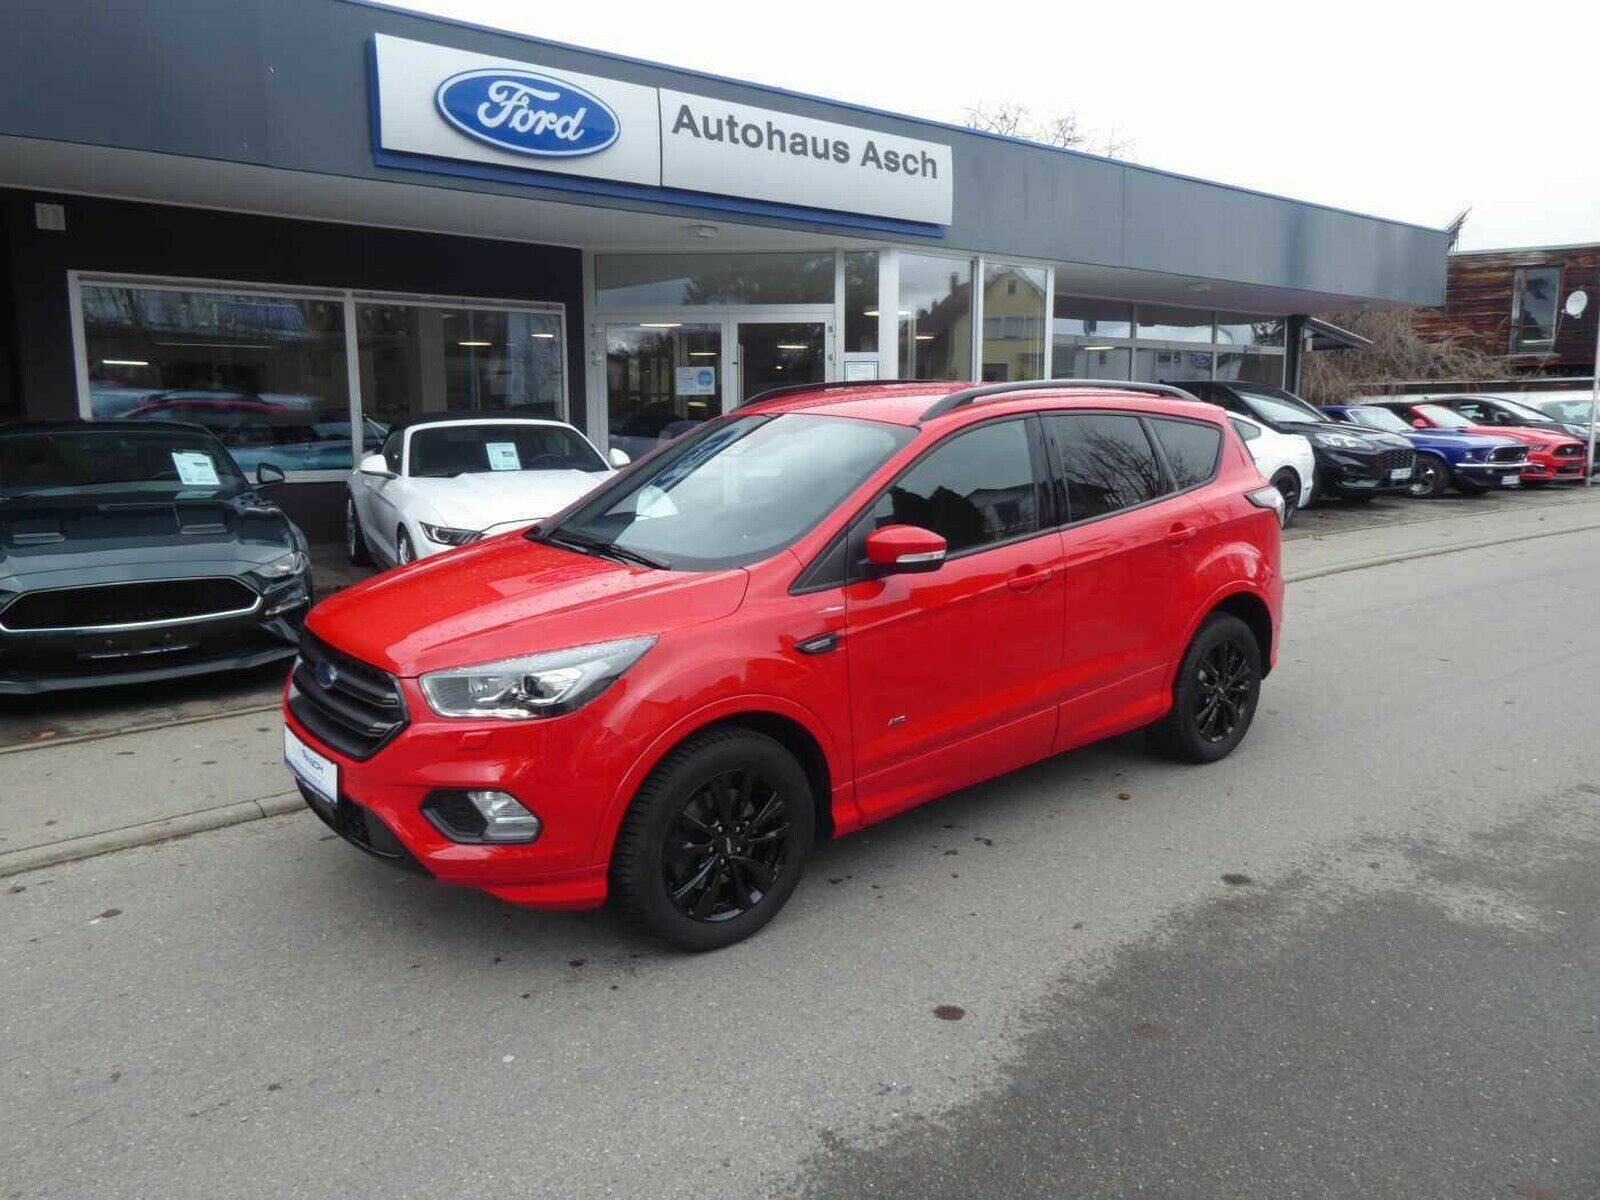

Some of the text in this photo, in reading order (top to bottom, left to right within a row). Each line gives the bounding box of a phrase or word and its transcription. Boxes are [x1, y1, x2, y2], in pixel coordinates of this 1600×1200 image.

[477, 80, 587, 142] Ford
[672, 104, 937, 179] Autohaus Asch
